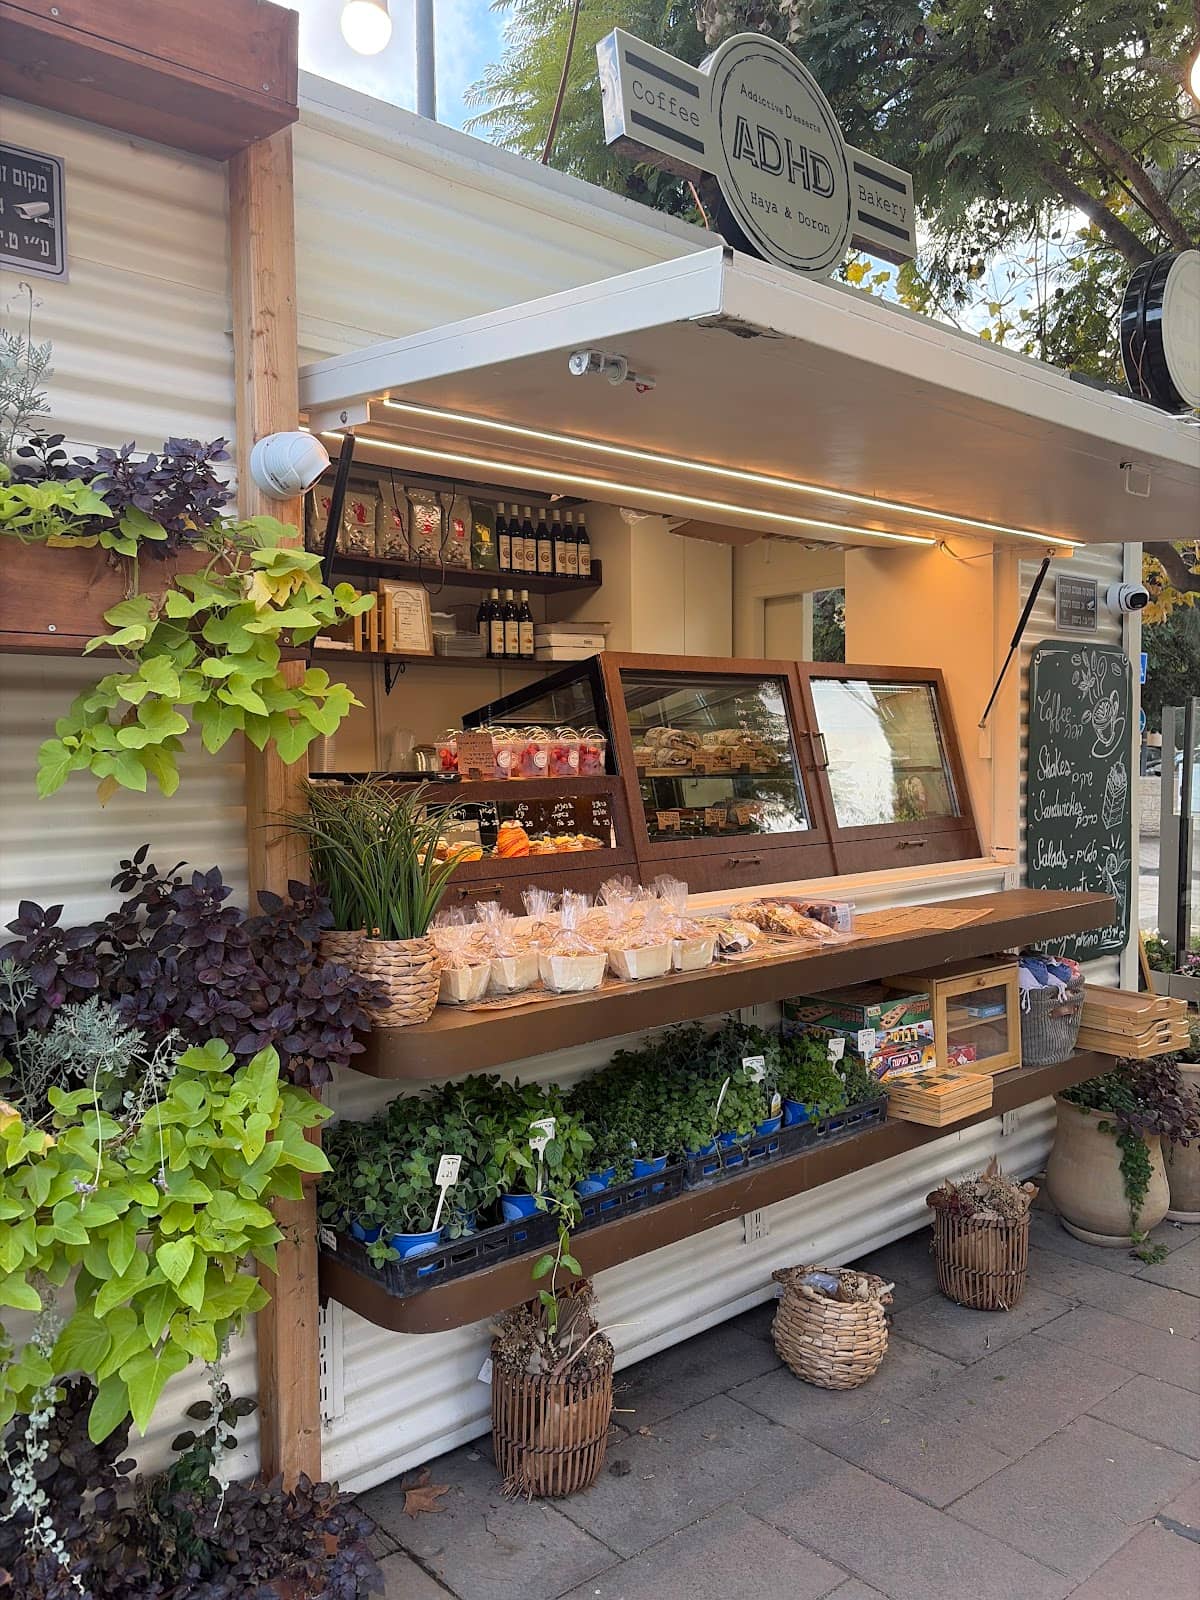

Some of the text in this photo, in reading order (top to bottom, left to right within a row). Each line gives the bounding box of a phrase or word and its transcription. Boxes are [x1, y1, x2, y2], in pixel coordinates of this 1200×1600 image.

[632, 80, 700, 127] Coffee
[740, 82, 822, 134] Addictive Desserts
[732, 114, 835, 199] ADHD
[12, 167, 48, 194] מקום
[750, 191, 831, 235] Haya & Doron
[857, 183, 908, 223] Bakery
[1032, 837, 1069, 871] Salads
